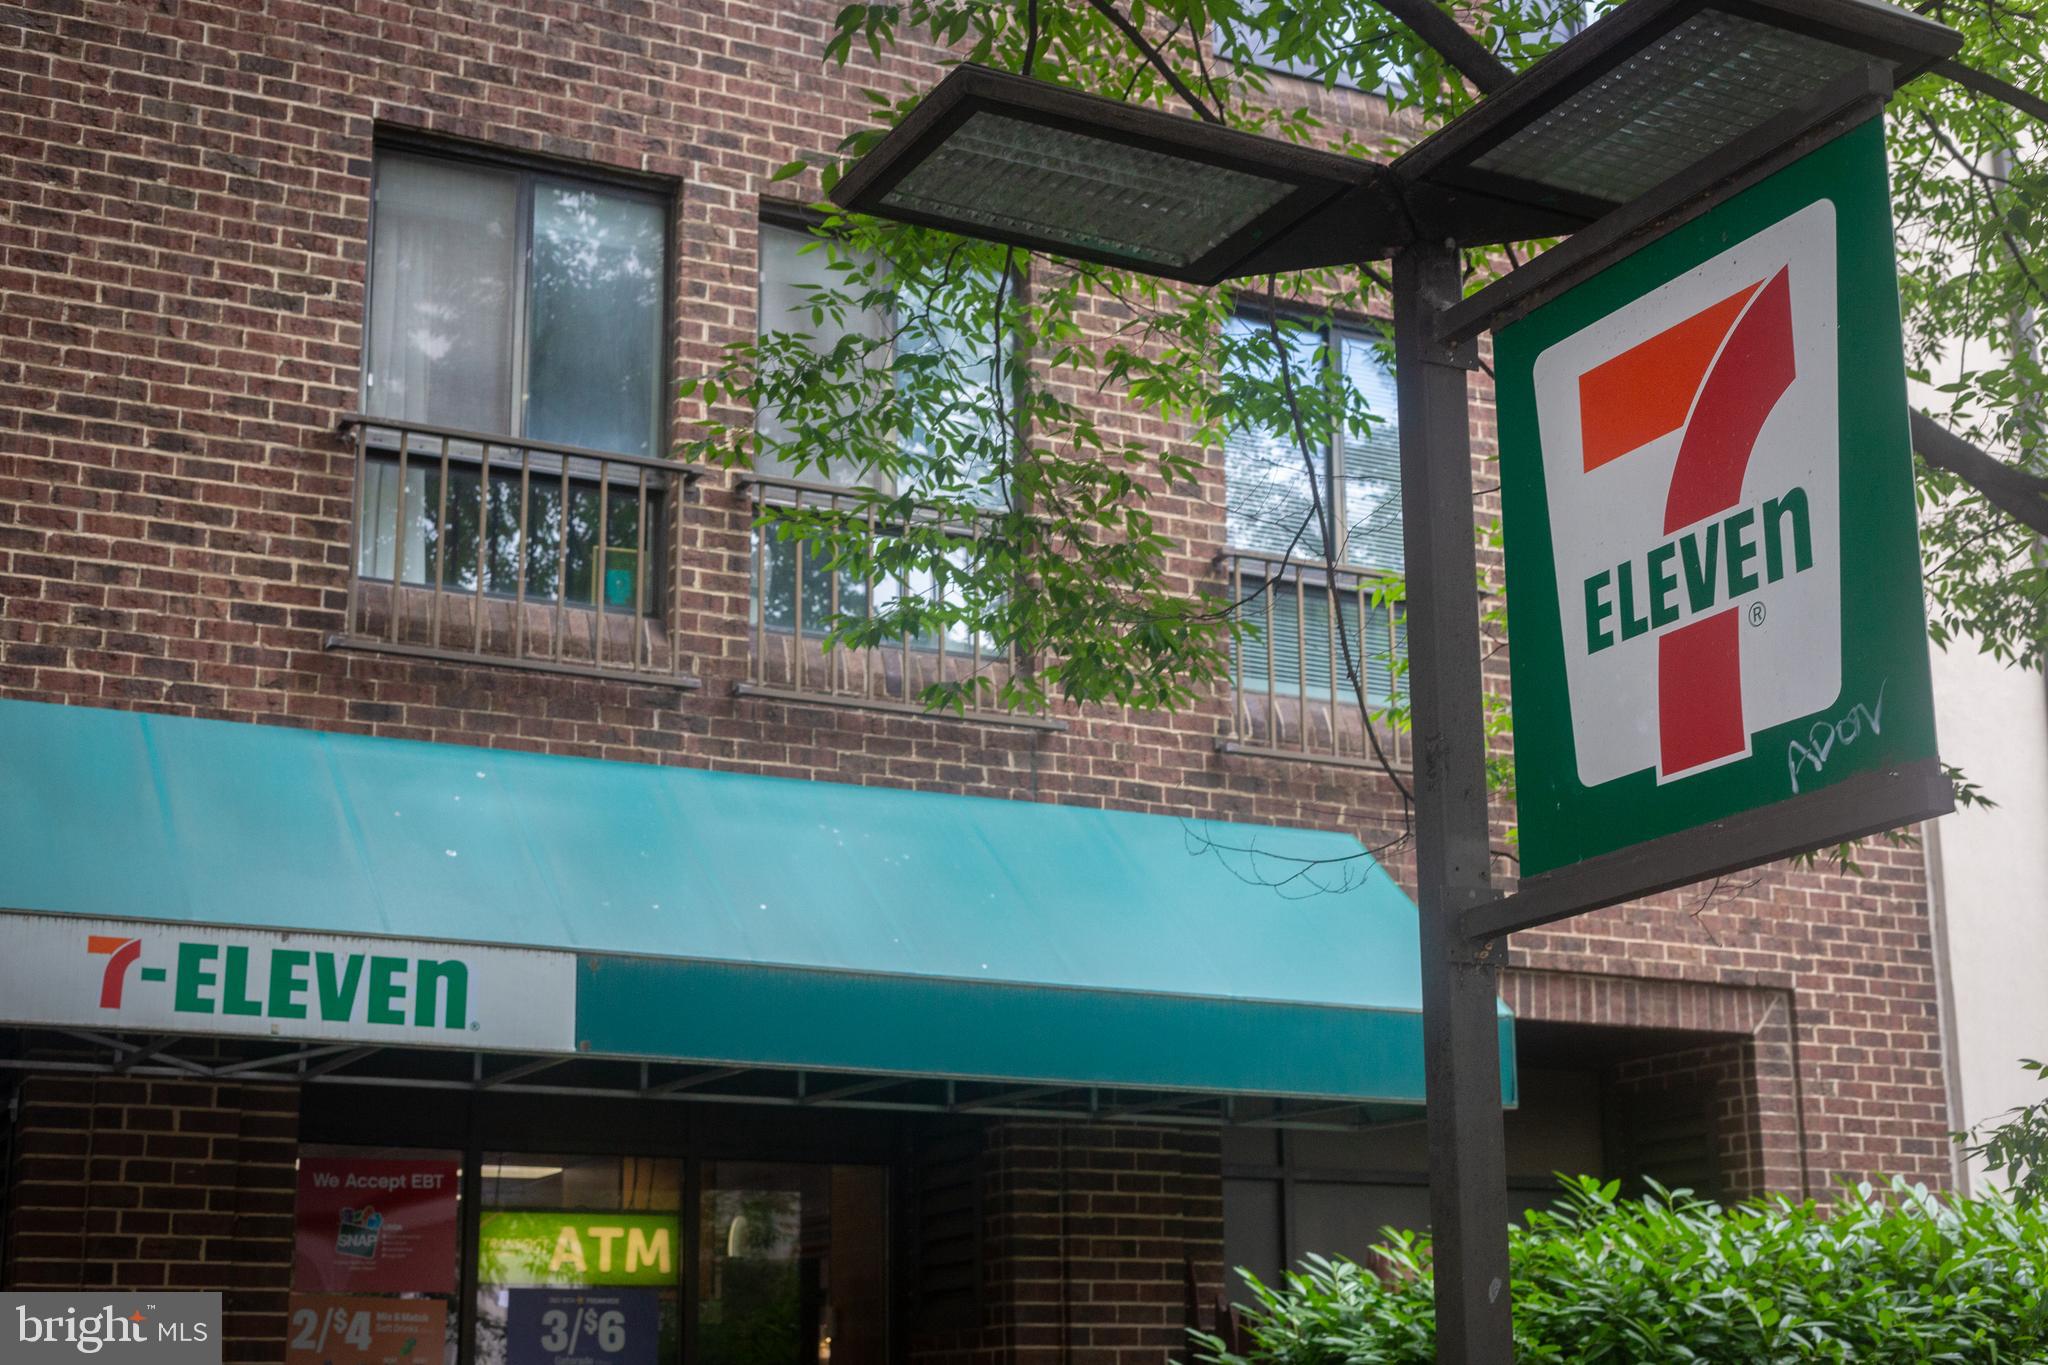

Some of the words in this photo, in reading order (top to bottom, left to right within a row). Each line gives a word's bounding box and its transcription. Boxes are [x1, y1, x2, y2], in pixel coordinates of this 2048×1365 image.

[1578, 263, 1797, 777] 7
[313, 1173, 340, 1188] We
[345, 1174, 407, 1192] Accept
[411, 1174, 444, 1189] EBT
[337, 1234, 378, 1248] SNAP
[549, 1226, 671, 1274] ATM
